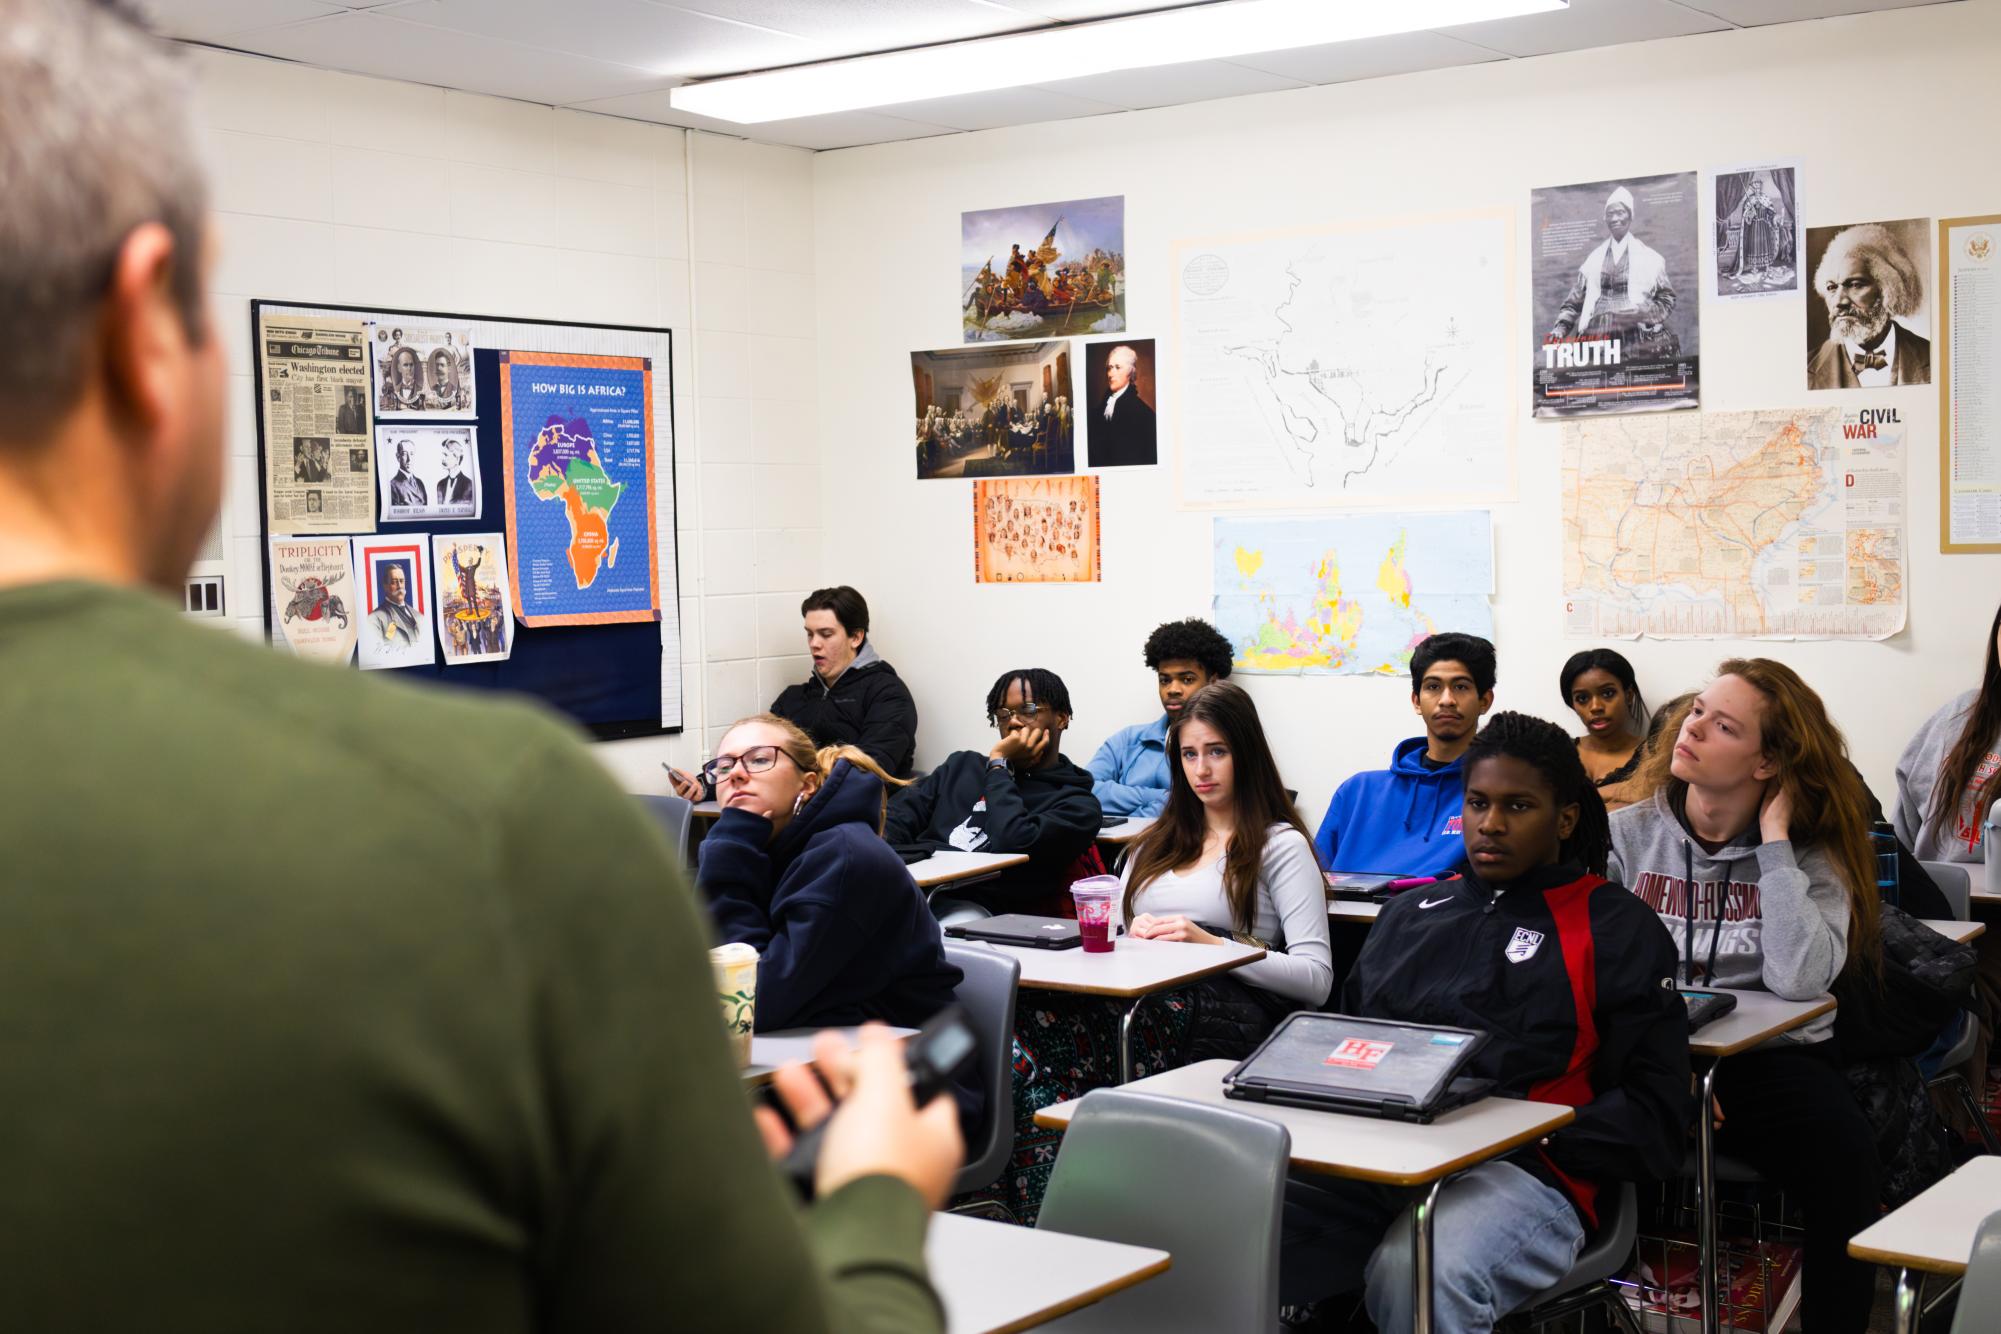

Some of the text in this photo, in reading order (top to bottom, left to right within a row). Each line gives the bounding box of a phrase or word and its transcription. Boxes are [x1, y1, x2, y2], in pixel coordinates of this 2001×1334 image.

[291, 344, 317, 356] Chicago
[316, 345, 340, 356] Tribune
[1542, 339, 1621, 369] TRUTH
[291, 361, 336, 375] Washington
[339, 364, 365, 375] elected
[532, 383, 626, 397] HOW BIG IS AFRICA?
[1859, 408, 1901, 425] CIVIL
[1843, 424, 1877, 439] WAR
[1846, 474, 1855, 487] D
[278, 545, 344, 558] TRIPLICITY
[1566, 602, 1574, 613] C
[1514, 930, 1540, 945] ECNL
[1341, 1041, 1385, 1061] HF
